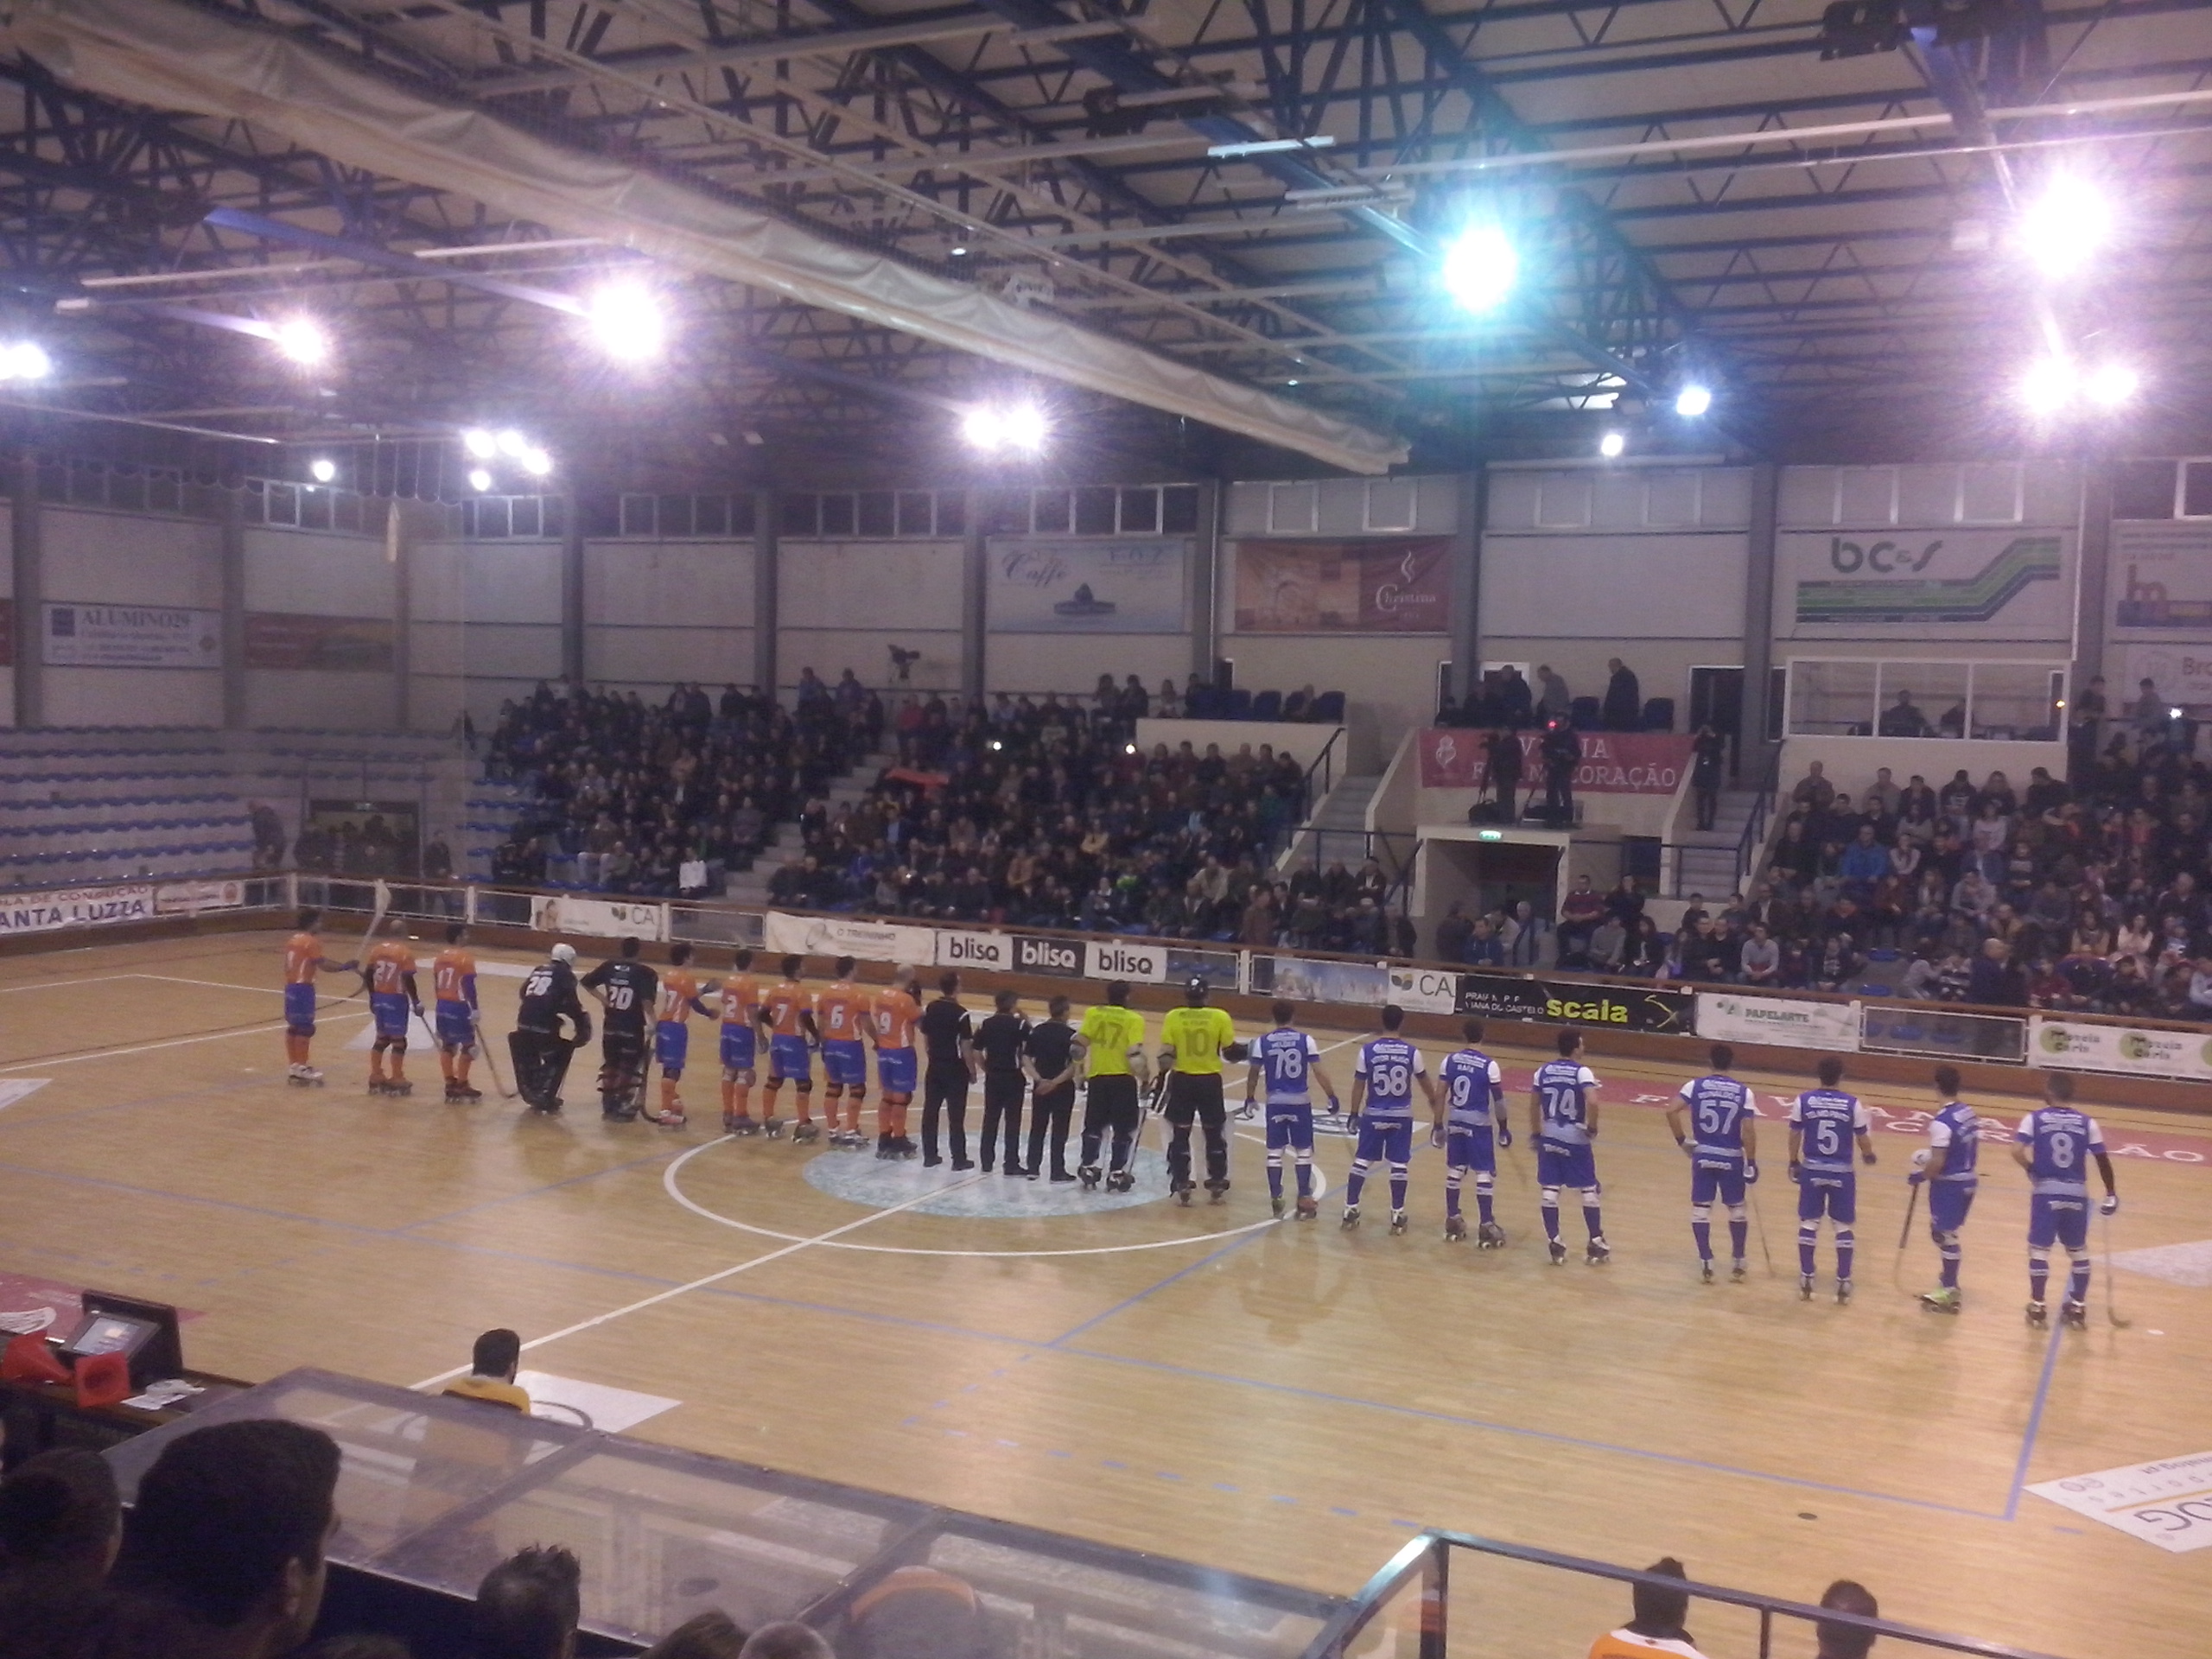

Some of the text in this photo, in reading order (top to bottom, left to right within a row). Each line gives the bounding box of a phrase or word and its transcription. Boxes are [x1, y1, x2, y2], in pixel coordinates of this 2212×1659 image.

[1419, 975, 1455, 997] CA
[1546, 998, 1629, 1023] scala
[1183, 1027, 1210, 1057] 10
[1267, 1047, 1303, 1079] 78
[1372, 1064, 1408, 1096] 58
[1452, 1074, 1471, 1107] 9
[1541, 1086, 1578, 1121] 74
[1699, 1099, 1739, 1135] 57
[1816, 1120, 1839, 1155] 5
[2050, 1132, 2075, 1168] 8
